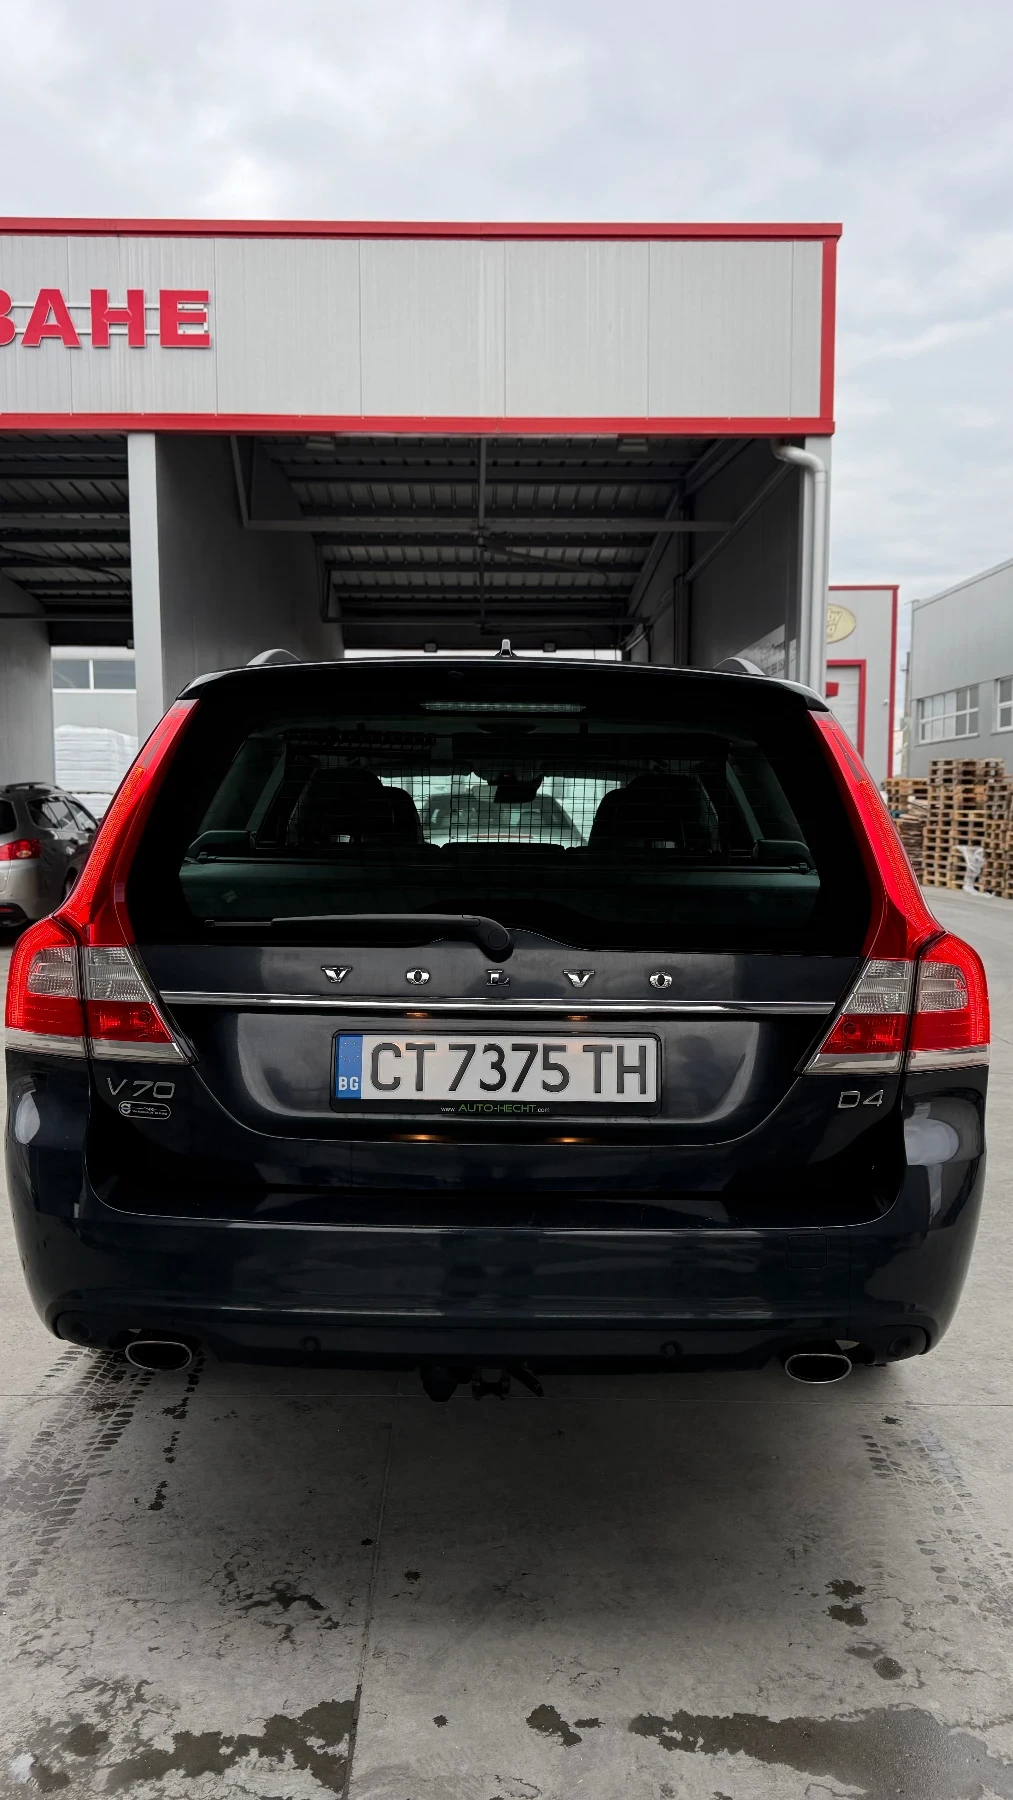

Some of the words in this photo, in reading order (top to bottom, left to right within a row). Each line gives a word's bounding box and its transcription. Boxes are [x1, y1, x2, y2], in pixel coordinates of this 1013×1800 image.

[321, 966, 673, 989] VOLVO
[371, 1042, 435, 1091] CT
[448, 1043, 570, 1093] 7375
[582, 1044, 647, 1095] TH
[338, 1077, 359, 1091] BG
[458, 1103, 537, 1113] AUTO-HECHT
[837, 1089, 884, 1108] D4
